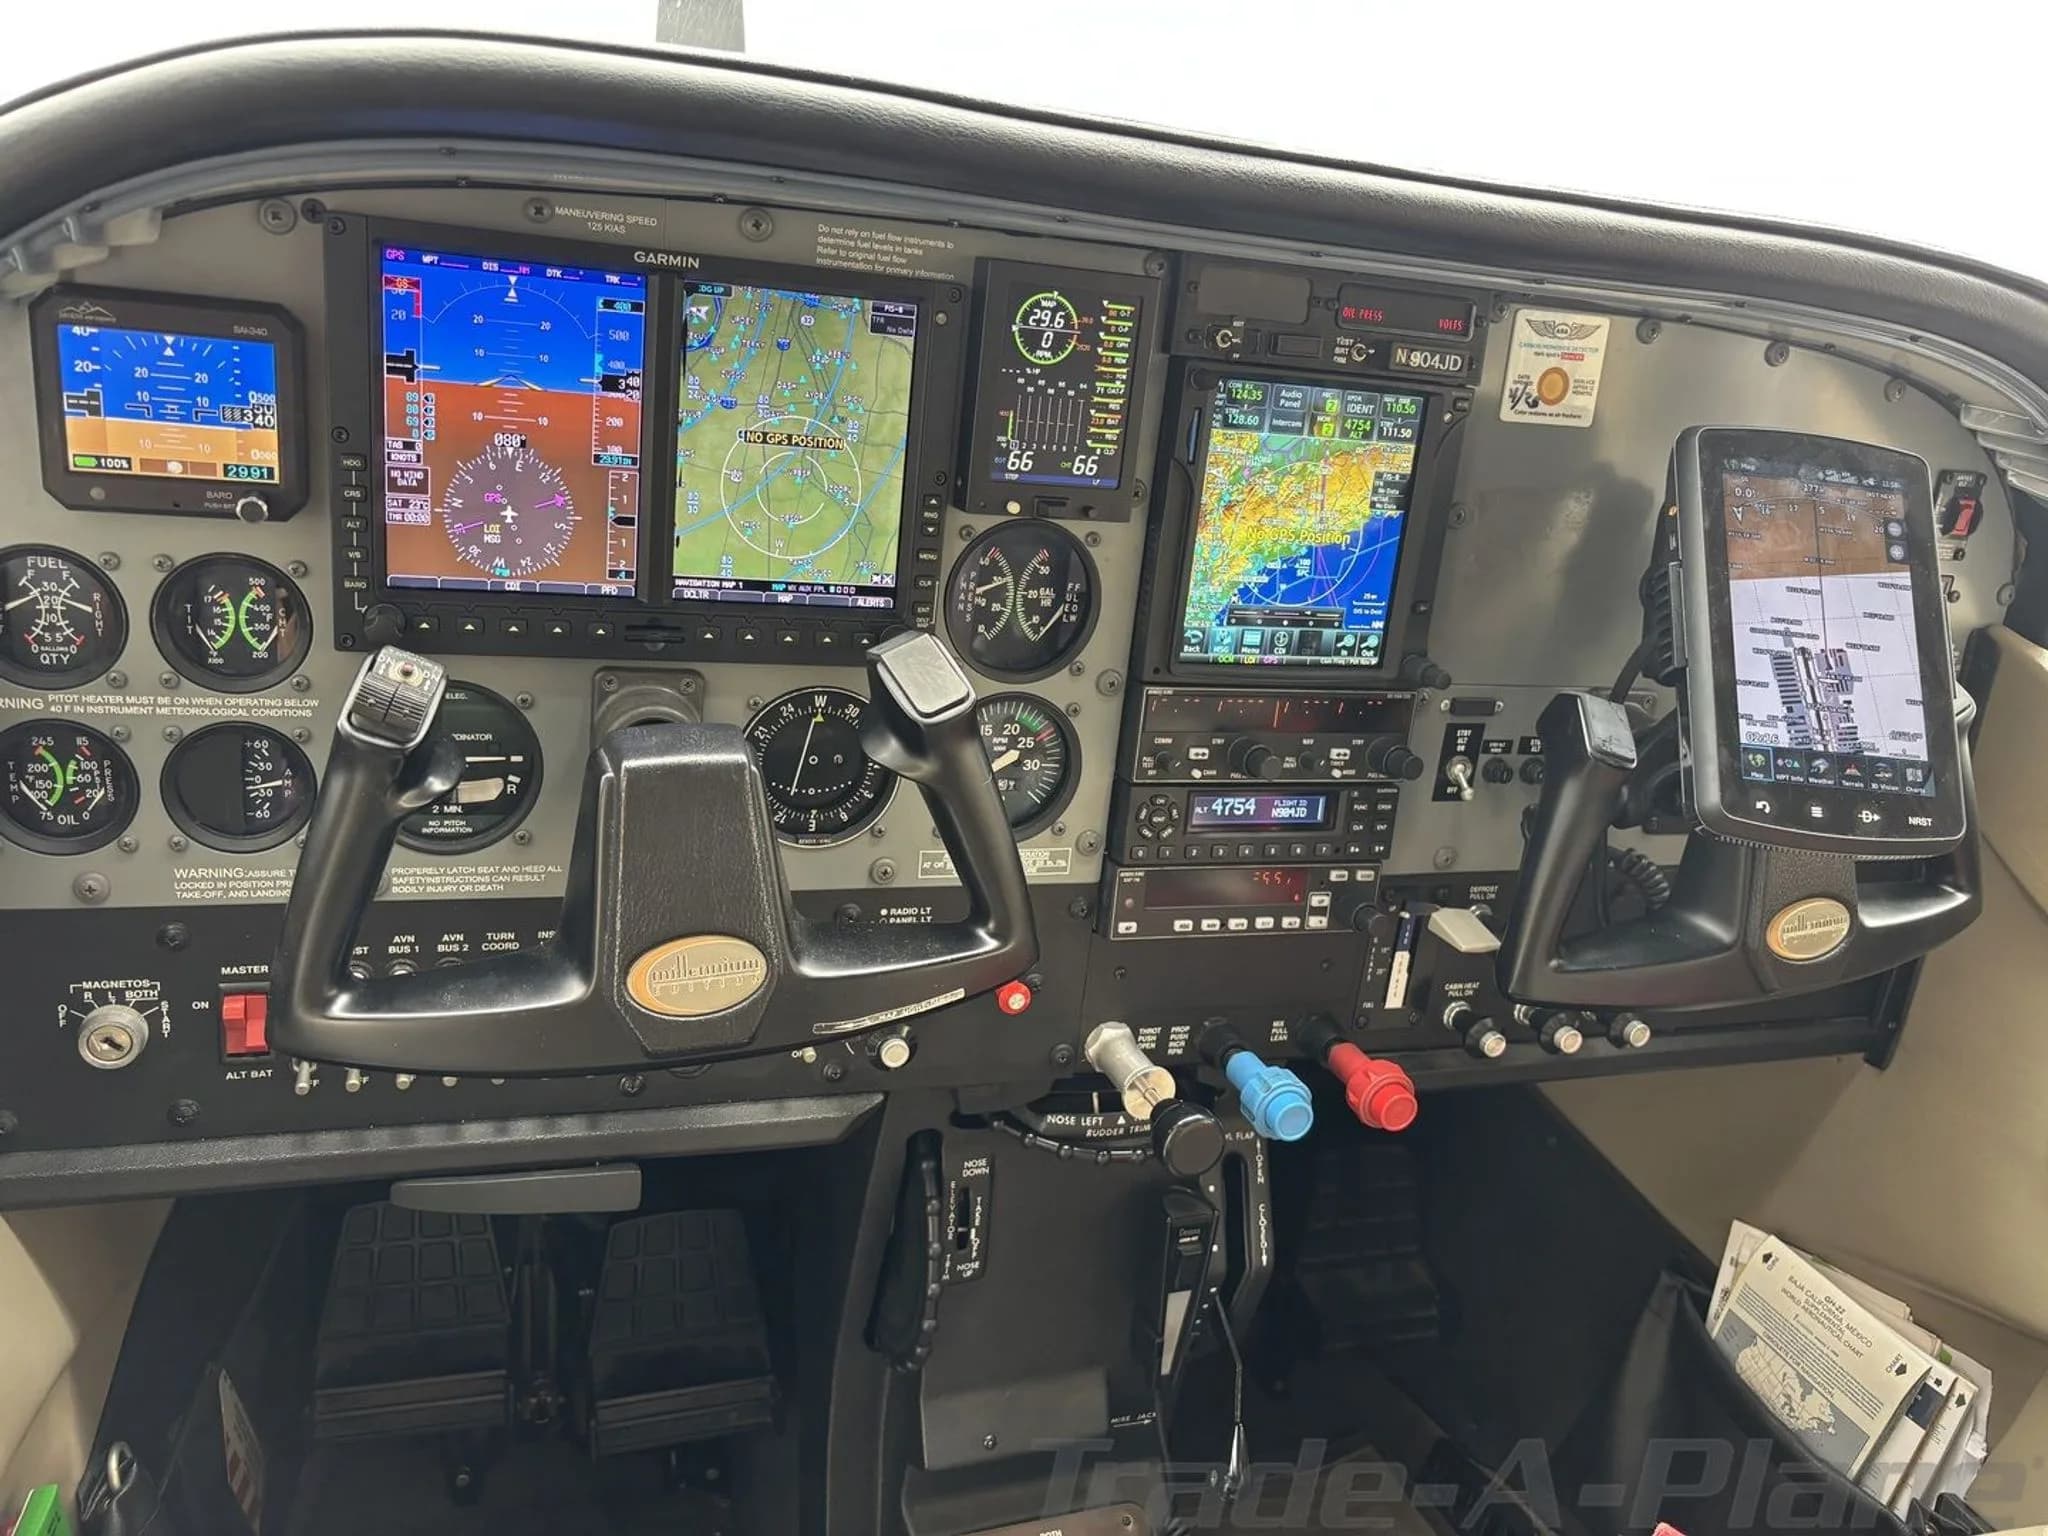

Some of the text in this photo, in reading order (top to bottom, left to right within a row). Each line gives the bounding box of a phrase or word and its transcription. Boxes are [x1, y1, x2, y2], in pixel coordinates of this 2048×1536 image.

[555, 207, 657, 226] MANEUVERING SPEED
[587, 222, 625, 234] 125 KIAS
[818, 224, 830, 233] Do
[831, 227, 843, 235] not
[845, 228, 859, 238] rely
[872, 231, 886, 240] fuel
[887, 233, 902, 242] flow
[947, 241, 954, 249] to
[857, 239, 871, 249] fuel
[872, 241, 893, 252] levels
[895, 244, 902, 252] in
[904, 245, 923, 255] tanks
[386, 249, 404, 260] GPS
[422, 255, 438, 264] WPT
[634, 251, 699, 269] GARMIN
[817, 245, 907, 264] Refer to original fuel flow
[482, 262, 498, 272] DIS
[875, 263, 884, 271] for
[886, 266, 913, 277] primary
[547, 269, 562, 278] DTK
[605, 275, 620, 284] TRK
[1029, 310, 1064, 328] 29.6
[1360, 309, 1383, 321] PRESS
[74, 361, 92, 373] 20
[1231, 389, 1263, 400] 124.35
[1280, 388, 1302, 399] Audio
[1279, 399, 1302, 409] Panel
[1347, 403, 1374, 414] IDENT
[1386, 403, 1416, 414] 110.50
[1228, 413, 1259, 425] 128.60
[1272, 418, 1302, 428] Intercom
[1344, 419, 1371, 431] 4754
[1382, 427, 1411, 438] 111.50
[746, 431, 843, 449] NO GPS POSITION
[391, 453, 417, 462] KNOTS
[1007, 451, 1033, 471] 66
[100, 458, 129, 469] 100%
[1072, 456, 1098, 475] 66
[206, 491, 232, 500] BARO
[1247, 526, 1350, 544] No GPS Position
[27, 556, 68, 569] FUEL
[41, 582, 58, 592] 30
[248, 578, 265, 586] 500
[683, 590, 709, 599] DCLTR
[857, 598, 884, 608] ALERTS
[93, 592, 104, 637] RIGHT
[40, 653, 70, 665] QTY
[48, 694, 79, 703] PITOT
[81, 695, 124, 704] HEATER
[125, 696, 154, 705] MUST
[157, 697, 172, 705] BE
[174, 697, 189, 705] ON
[191, 697, 222, 705] WHEN
[224, 698, 282, 706] OPERATING
[284, 699, 320, 707] BELOW
[50, 704, 312, 717] 40 F IN INSTRUMENT METEOROLOGICAL CONDITIONS
[1003, 723, 1020, 735] 20
[32, 737, 54, 745] 245
[1017, 736, 1034, 748] 25
[27, 763, 48, 772] 200
[80, 761, 98, 770] 100
[1023, 759, 1040, 771] 30
[35, 780, 53, 789] 150
[1808, 776, 1835, 785] Weather
[1841, 780, 1864, 788] Terrain
[1212, 798, 1257, 816] 4754
[1271, 807, 1307, 817] N904JD
[57, 814, 80, 825] OIL
[1908, 816, 1933, 827] NRST
[422, 826, 473, 834] INFORMATION
[391, 866, 446, 875] PROPERELY
[447, 866, 476, 874] LATCH
[477, 866, 500, 874] SEAT
[521, 865, 546, 873] HEED
[174, 881, 215, 890] LOCKED
[216, 881, 227, 889] IN
[229, 880, 274, 889] POSITION
[392, 884, 504, 894] BODILY INJURY OR DEATH
[228, 890, 249, 898] AND
[890, 907, 918, 915] RADIO
[393, 935, 415, 943] AVN
[442, 934, 464, 942] AVN
[486, 932, 515, 941] TURN
[482, 942, 520, 950] COORD
[221, 965, 269, 975] MASTER
[652, 954, 760, 983] millennium
[82, 980, 150, 989] MAGNETOS
[1445, 983, 1463, 991] CABIN
[125, 989, 159, 999] BOTH
[192, 1001, 209, 1010] ON
[160, 1001, 171, 1039] START
[1171, 1025, 1190, 1033] PROP
[225, 1069, 273, 1080] ALT BAT
[1047, 1114, 1104, 1127] NOSE LEFT
[964, 1158, 987, 1169] NOSE
[1256, 1154, 1264, 1184] OPEN
[962, 1167, 990, 1177] DOWN
[1258, 1203, 1267, 1249] CLOSED
[957, 1261, 980, 1271] NOSE
[1788, 1275, 1805, 1292] BAJA
[1846, 1322, 1873, 1349] MEXICO
[1804, 1299, 1845, 1336] SUPPLEMENTAL
[1781, 1287, 1801, 1307] WORLD
[1802, 1303, 1843, 1343] AERONAUTICAL
[1843, 1340, 1864, 1359] CHART
[1885, 1353, 1903, 1374] CHART
[1789, 1355, 1801, 1369] FOR
[1800, 1365, 1834, 1399] NAVIGATION
